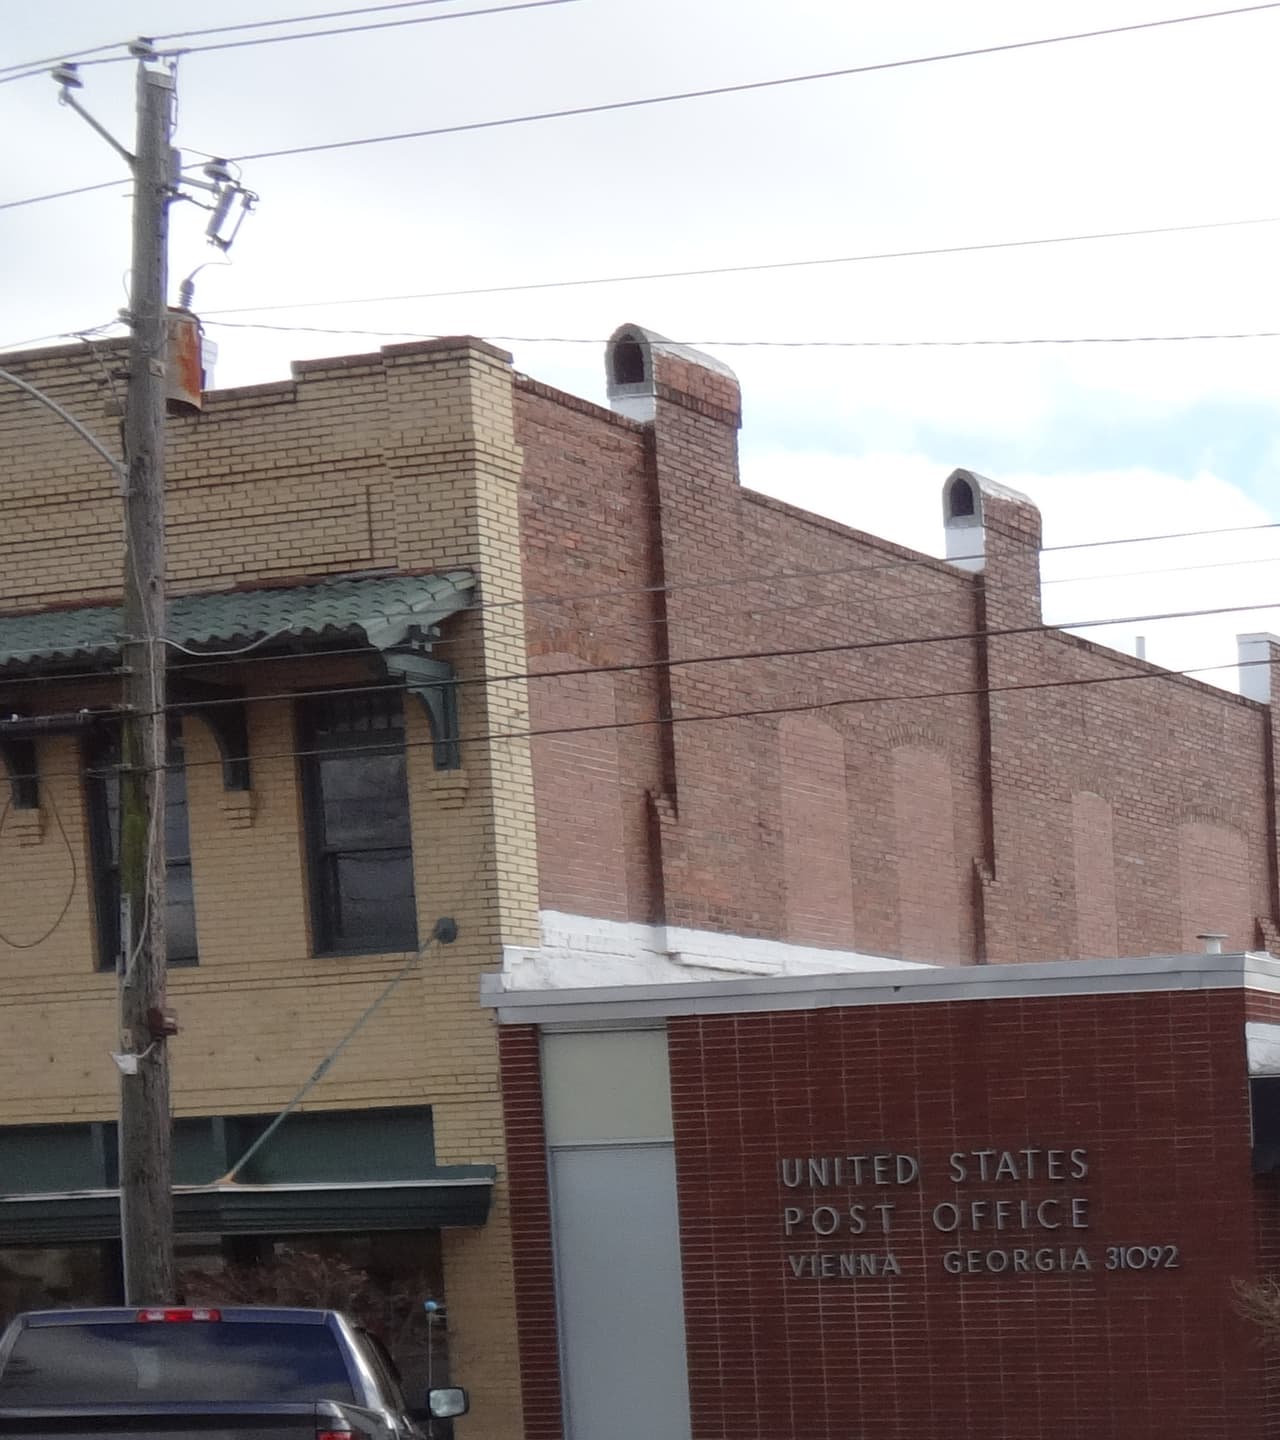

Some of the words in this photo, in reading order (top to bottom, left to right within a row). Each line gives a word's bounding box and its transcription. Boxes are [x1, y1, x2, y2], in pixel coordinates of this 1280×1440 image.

[782, 1154, 918, 1188] UNITED
[950, 1148, 1088, 1182] STATES
[784, 1202, 895, 1236] POST
[932, 1198, 1088, 1232] OFFICE
[788, 1253, 901, 1277] VIENNA
[942, 1247, 1092, 1274] GEORGIA
[1104, 1244, 1180, 1271] 31092
